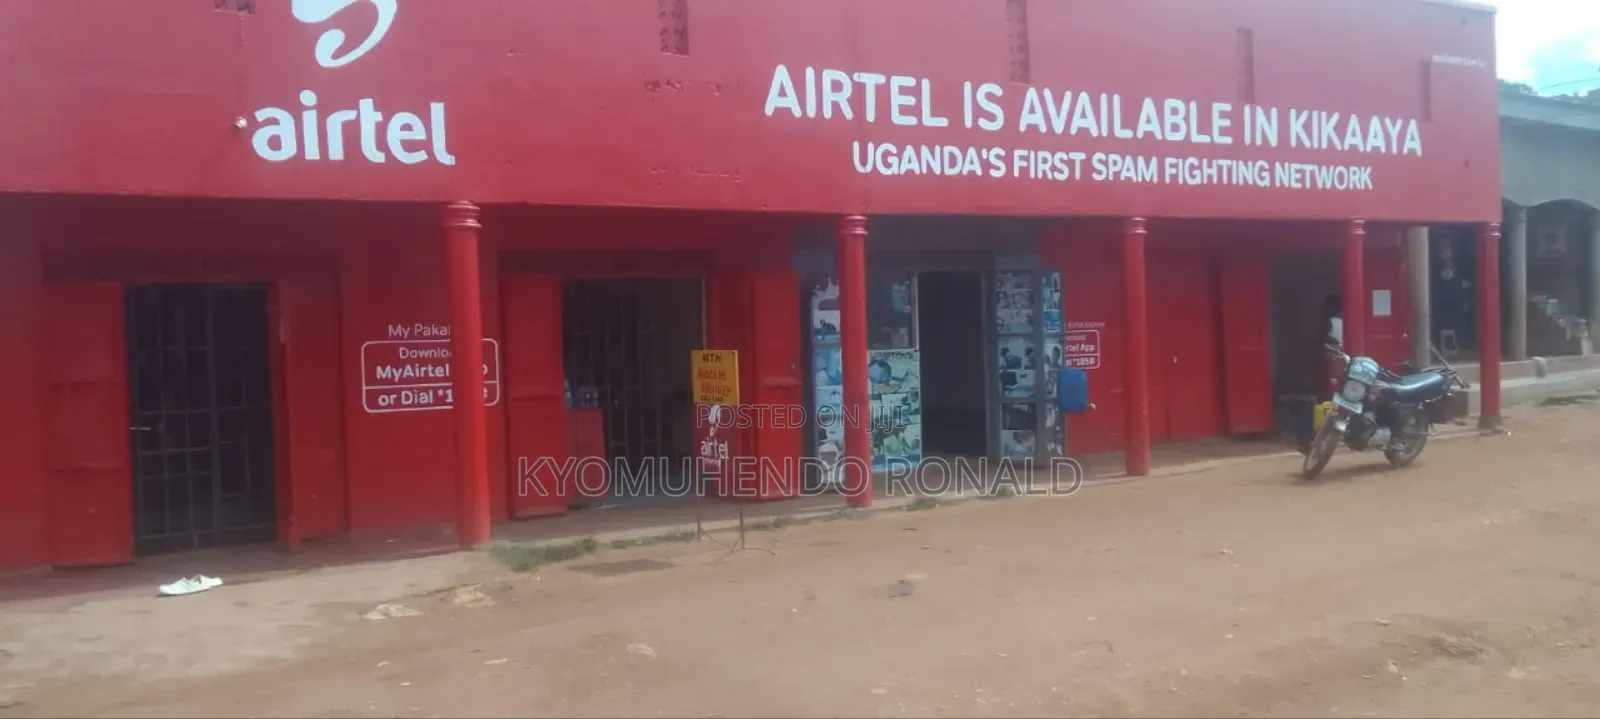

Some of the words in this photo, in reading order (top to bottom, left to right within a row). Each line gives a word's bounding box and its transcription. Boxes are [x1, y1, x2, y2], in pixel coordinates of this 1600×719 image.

[764, 64, 949, 127] AIRTEL
[963, 80, 1005, 131] IS
[1018, 87, 1233, 145] AVAILABLE
[1243, 104, 1278, 147] IN
[1289, 108, 1422, 156] KIKAAYA
[251, 89, 456, 166] airtel
[852, 140, 1007, 178] UGANDA'S
[1013, 149, 1087, 181] FIRST
[1091, 151, 1158, 183] SPAM
[1164, 156, 1271, 187] FIGHTING
[1274, 161, 1373, 190] NETWORK
[388, 324, 411, 339] My
[399, 347, 452, 359] Downlo
[702, 352, 722, 363] MTN
[376, 363, 450, 382] MyAirtel
[378, 394, 398, 407] or
[401, 389, 433, 405] Dial
[700, 436, 729, 460] airtel
